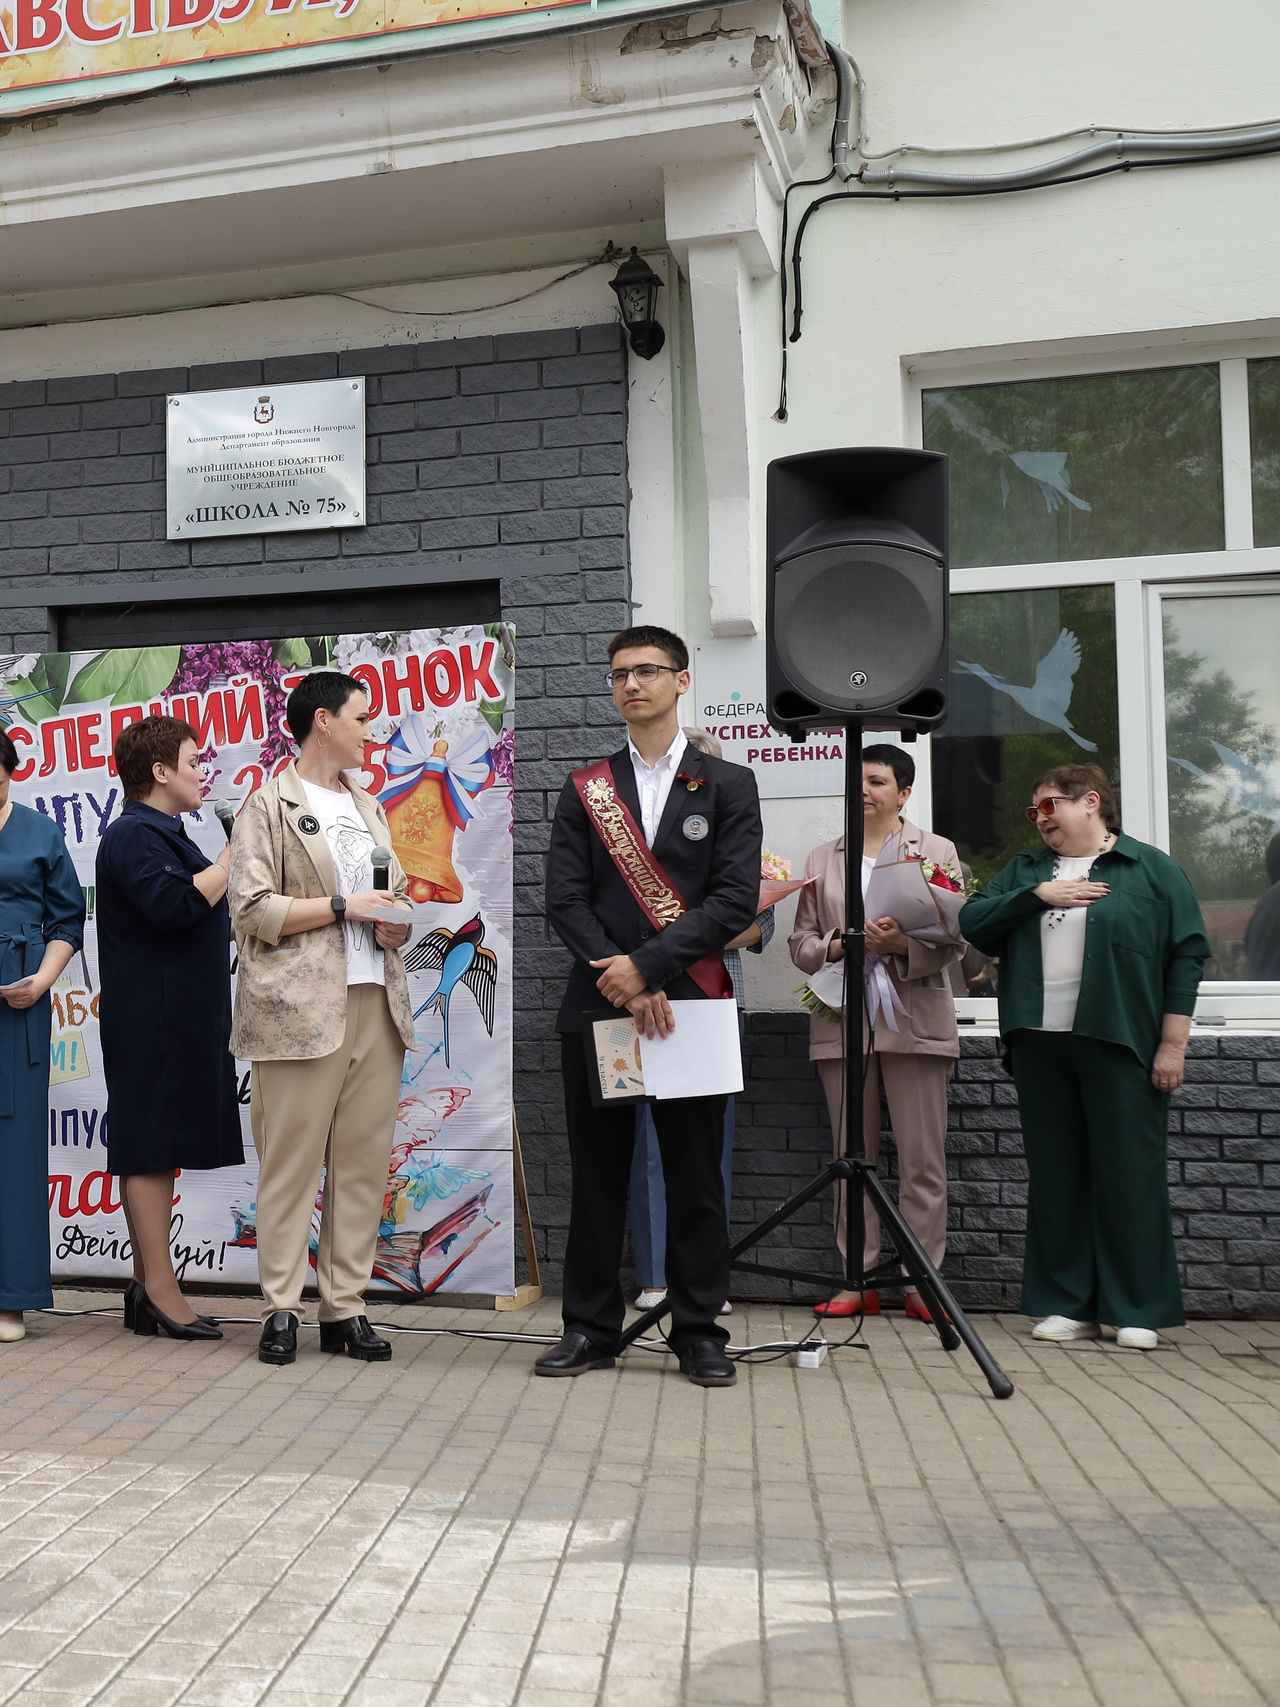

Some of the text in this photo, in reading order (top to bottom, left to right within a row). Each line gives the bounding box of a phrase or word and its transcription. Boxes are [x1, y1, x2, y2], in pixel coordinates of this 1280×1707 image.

[186, 423, 356, 443] Администрация города Нижнего Новгорода
[219, 436, 321, 451] Департамент образования
[186, 453, 345, 475] МУНИЦИПАЛЬНОЕ БЮДЖЕТНОЕ
[203, 466, 327, 483] ОБЩЕОБРАЗОВАТЕЛЬНОЕ
[230, 479, 299, 492] УЧРЕЖДЕНИЕ
[185, 497, 347, 524] «ШКОЛА № 75»
[747, 744, 844, 763] РЕБЕНКА
[55, 1213, 227, 1282] Дейсуй!
